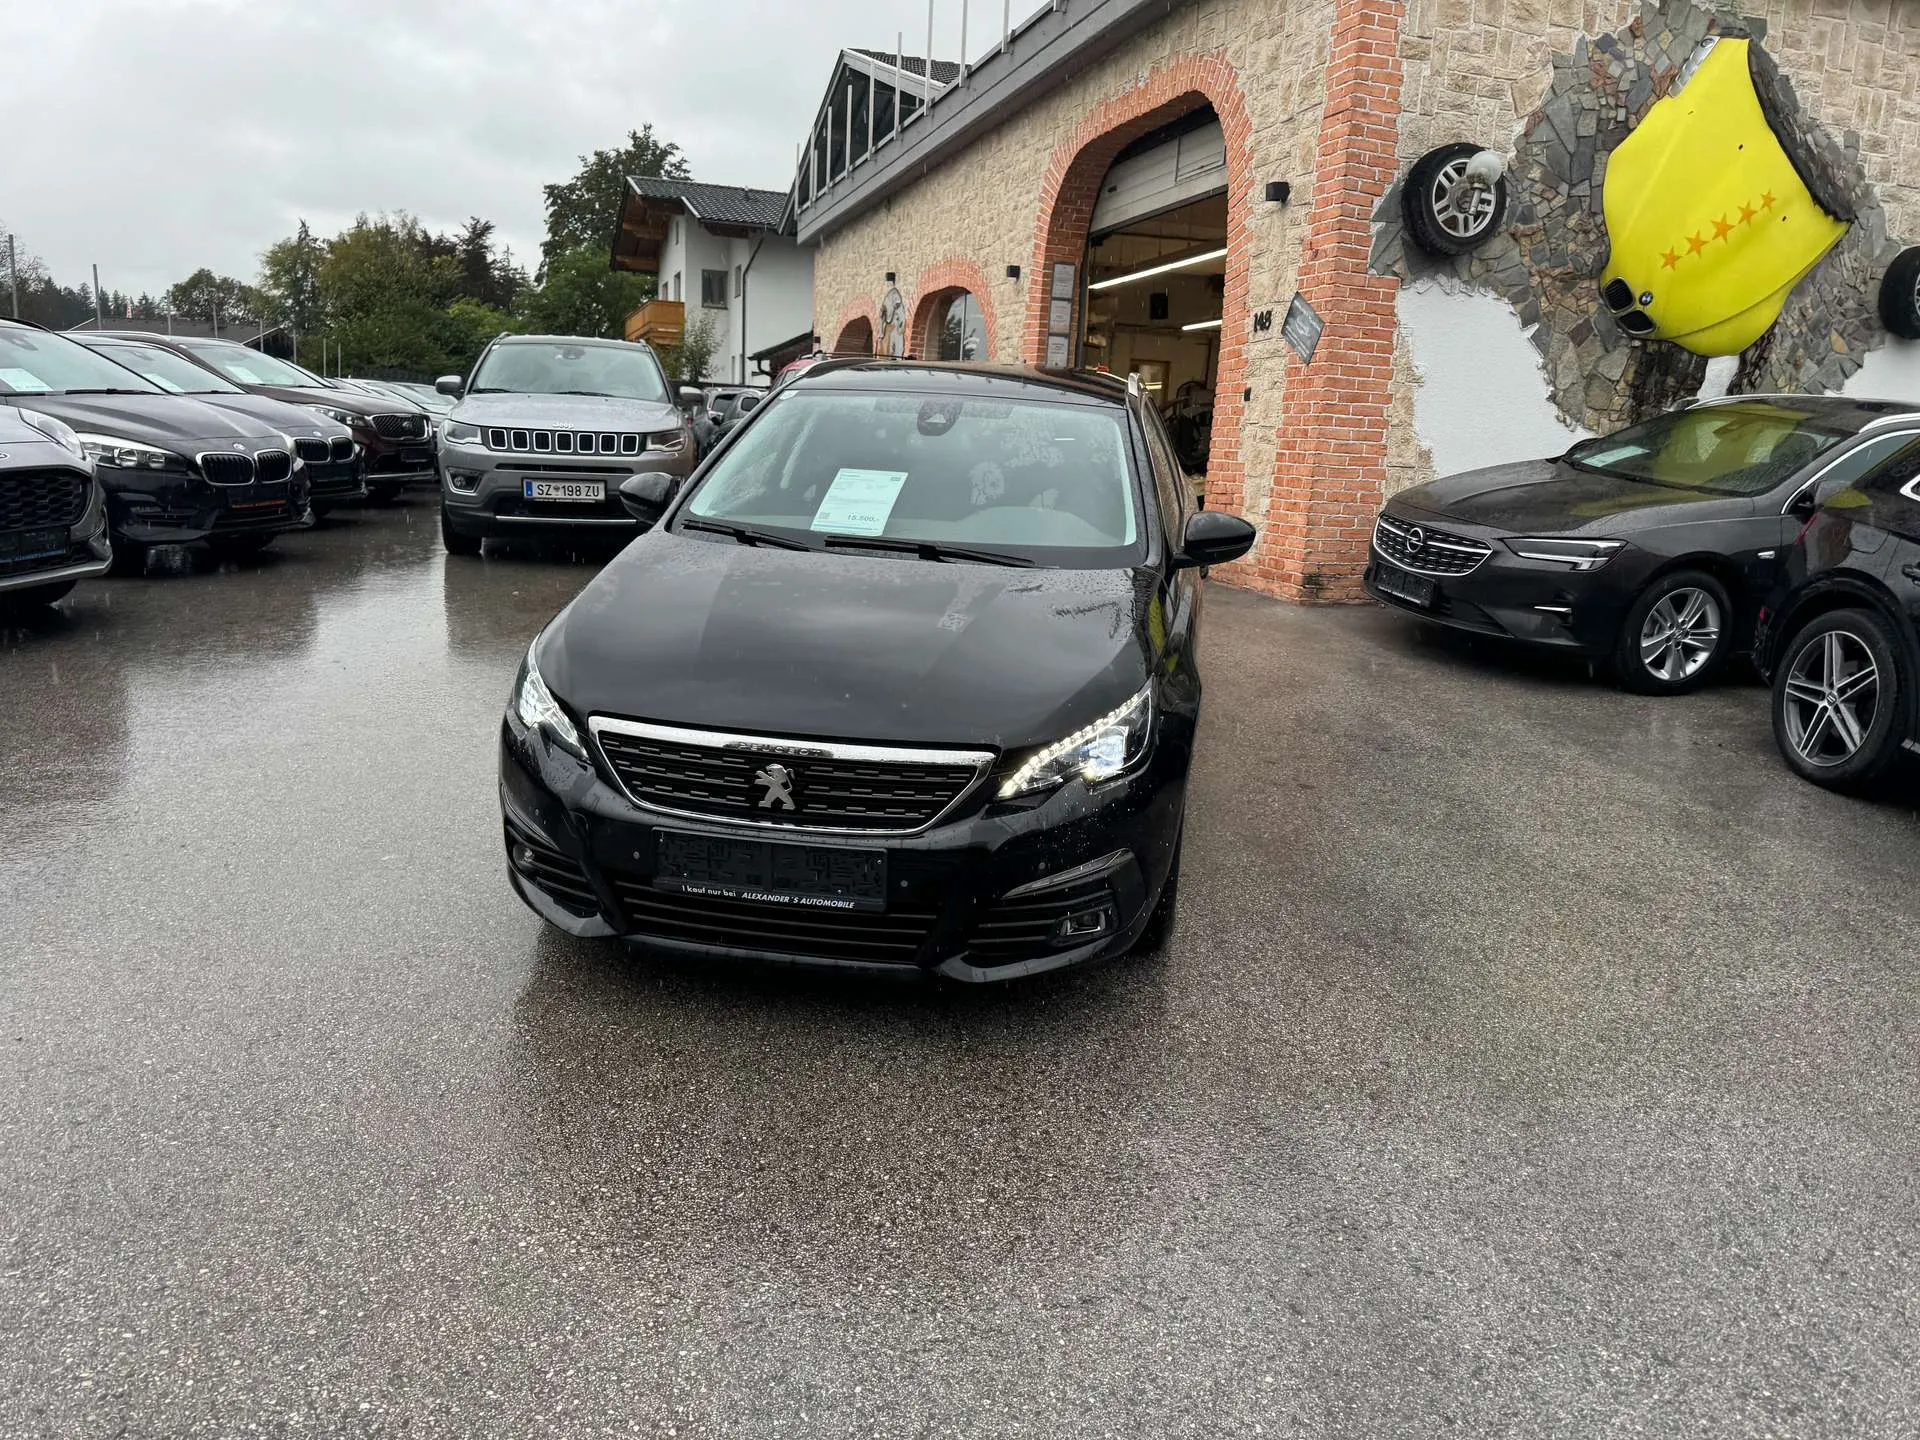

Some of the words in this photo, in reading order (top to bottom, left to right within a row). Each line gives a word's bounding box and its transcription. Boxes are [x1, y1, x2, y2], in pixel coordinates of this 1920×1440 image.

[537, 484, 552, 496] SZ
[561, 485, 582, 497] 198
[585, 486, 600, 497] ZU
[738, 741, 822, 757] PEUGEOT
[686, 885, 706, 894] kauf
[722, 889, 737, 897] bei
[800, 897, 855, 909] AUTOMOBILE
